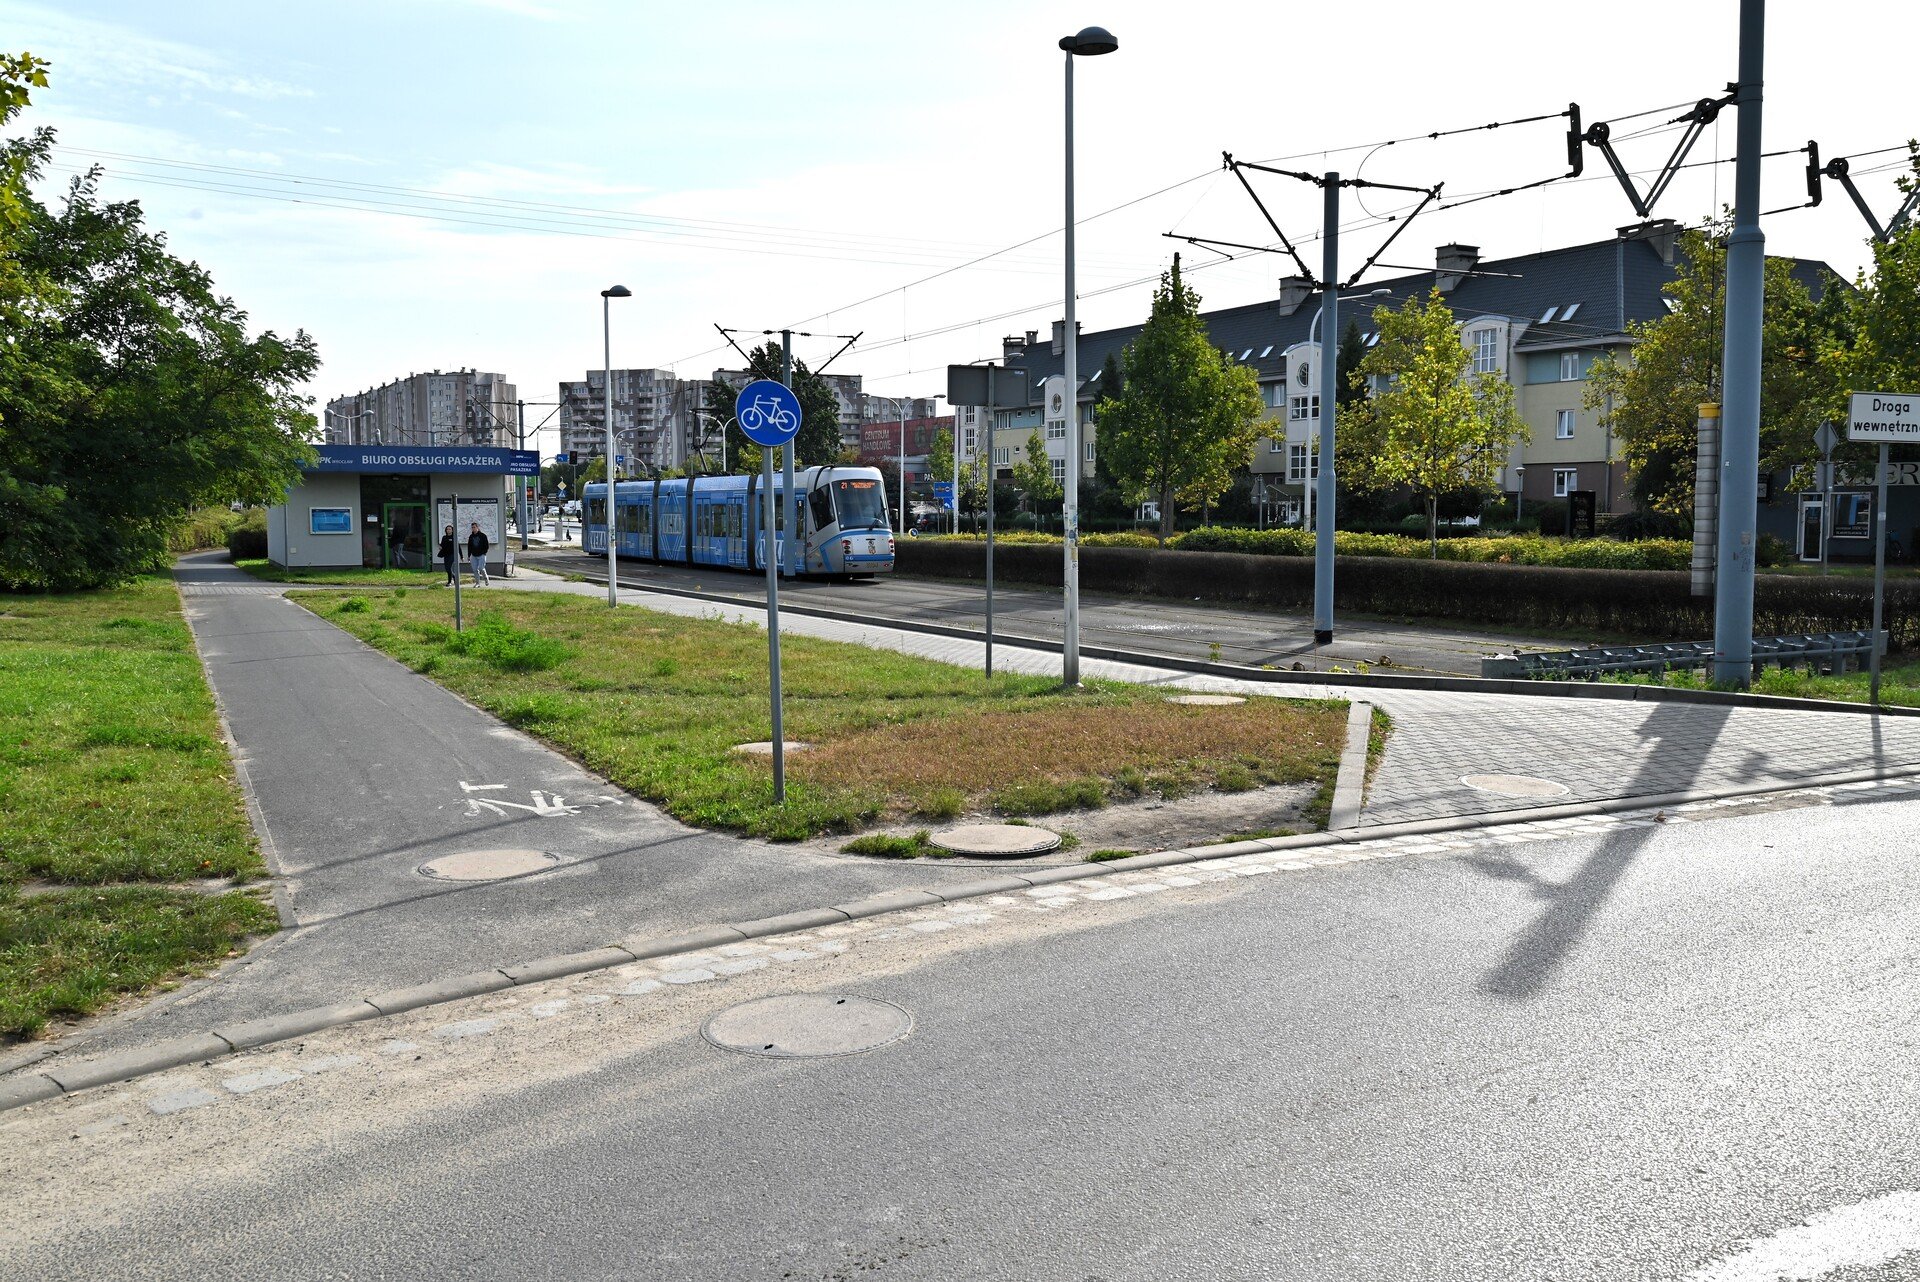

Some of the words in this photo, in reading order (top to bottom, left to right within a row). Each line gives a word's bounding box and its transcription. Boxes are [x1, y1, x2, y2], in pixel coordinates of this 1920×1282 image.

[1873, 398, 1910, 416] Droga
[1853, 420, 1920, 436] wewnętrzn
[864, 429, 890, 441] CENTRUM
[862, 440, 891, 451] HANDLOWE
[362, 455, 396, 465] BIURO
[398, 455, 446, 465] OBSŁUGI
[448, 455, 502, 466] PASAŻERA
